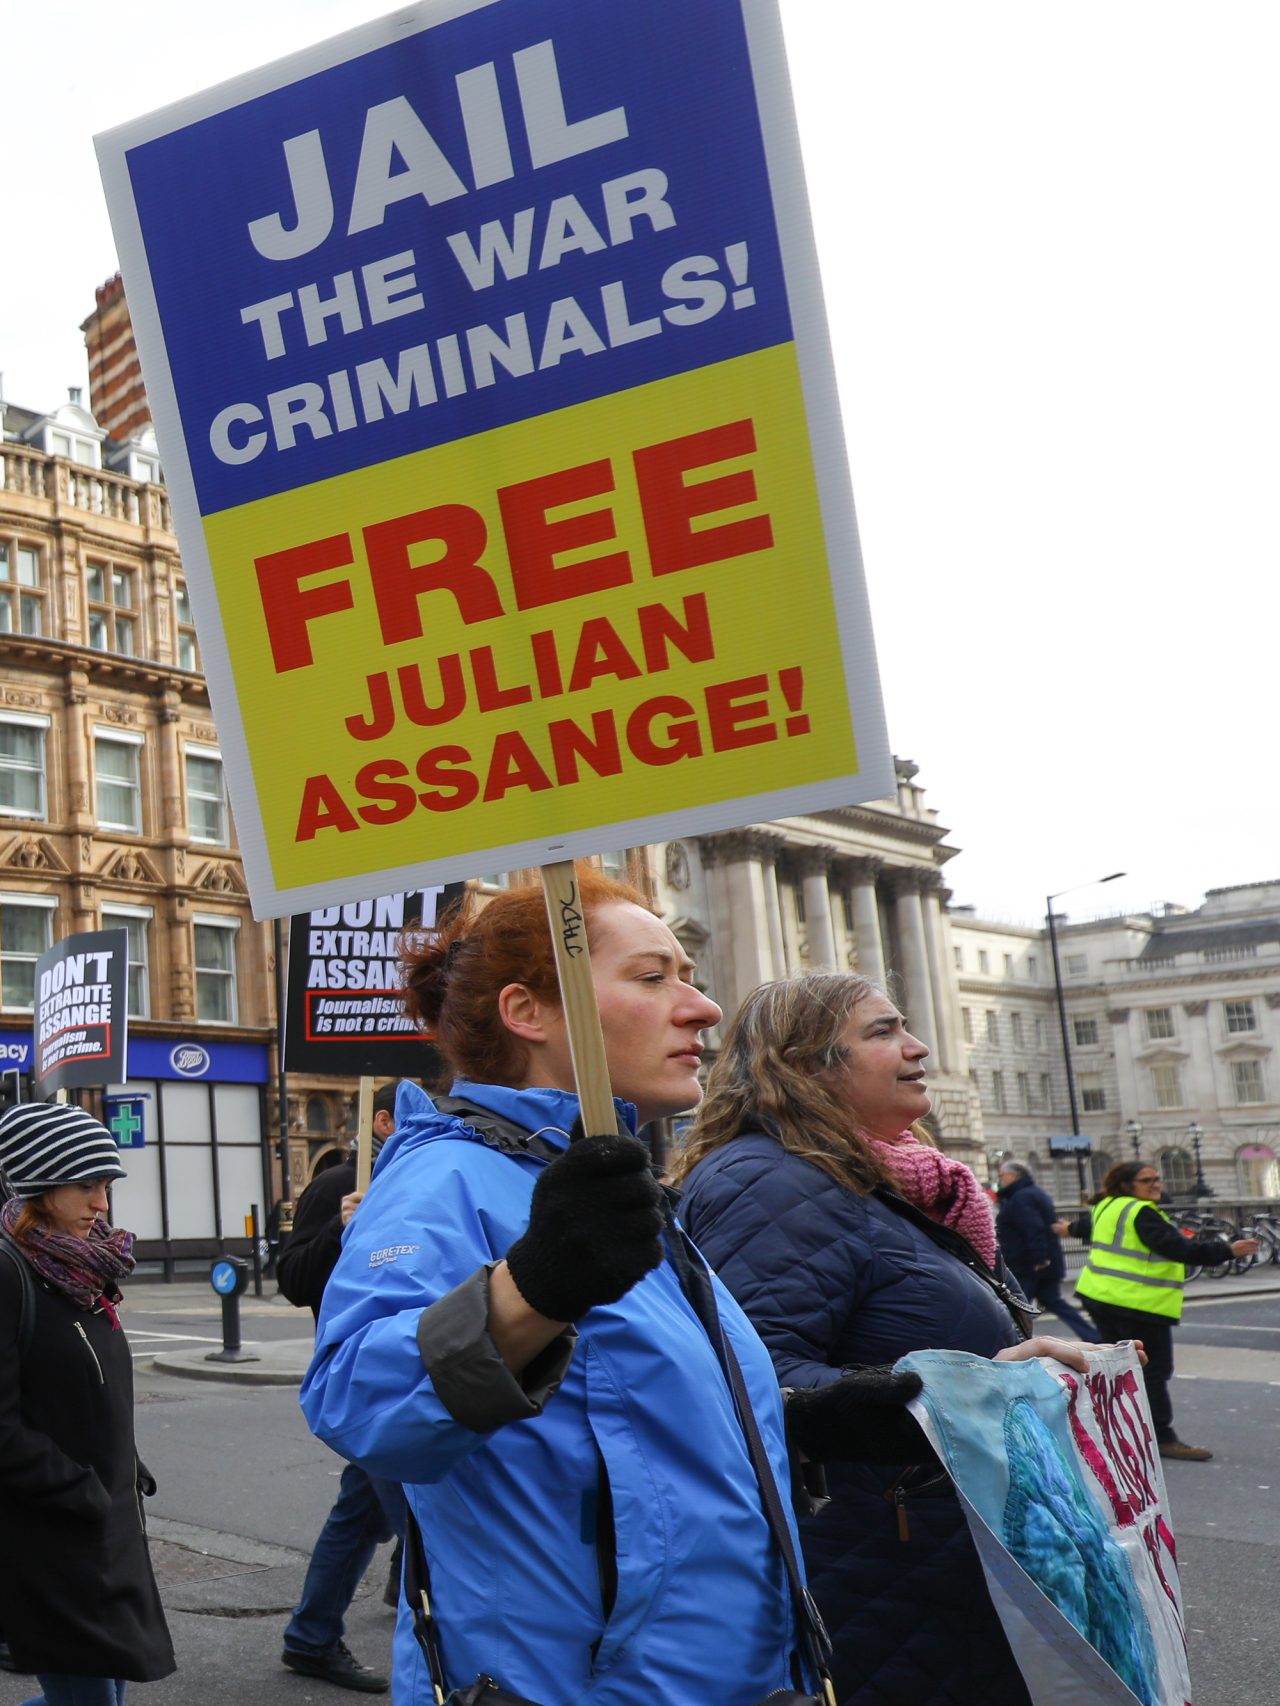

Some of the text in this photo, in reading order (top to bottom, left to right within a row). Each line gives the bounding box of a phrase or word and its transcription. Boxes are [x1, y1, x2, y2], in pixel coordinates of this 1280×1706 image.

[247, 39, 629, 261] JAIL
[241, 168, 677, 360] THE WAR
[209, 241, 758, 466] CRIMINALS!
[254, 418, 774, 674] FREE
[345, 592, 715, 740] JULIAN
[294, 667, 813, 842] ASSANGE!
[40, 951, 114, 1003] DON'T
[307, 959, 409, 990] ASSAN
[39, 1003, 111, 1045] ASSANGE
[40, 984, 112, 1020] EXTRADITE
[316, 1016, 332, 1032] is
[334, 1016, 363, 1032] not
[364, 1017, 376, 1031] a
[66, 1041, 103, 1056] crime.
[176, 1050, 203, 1069] Boots
